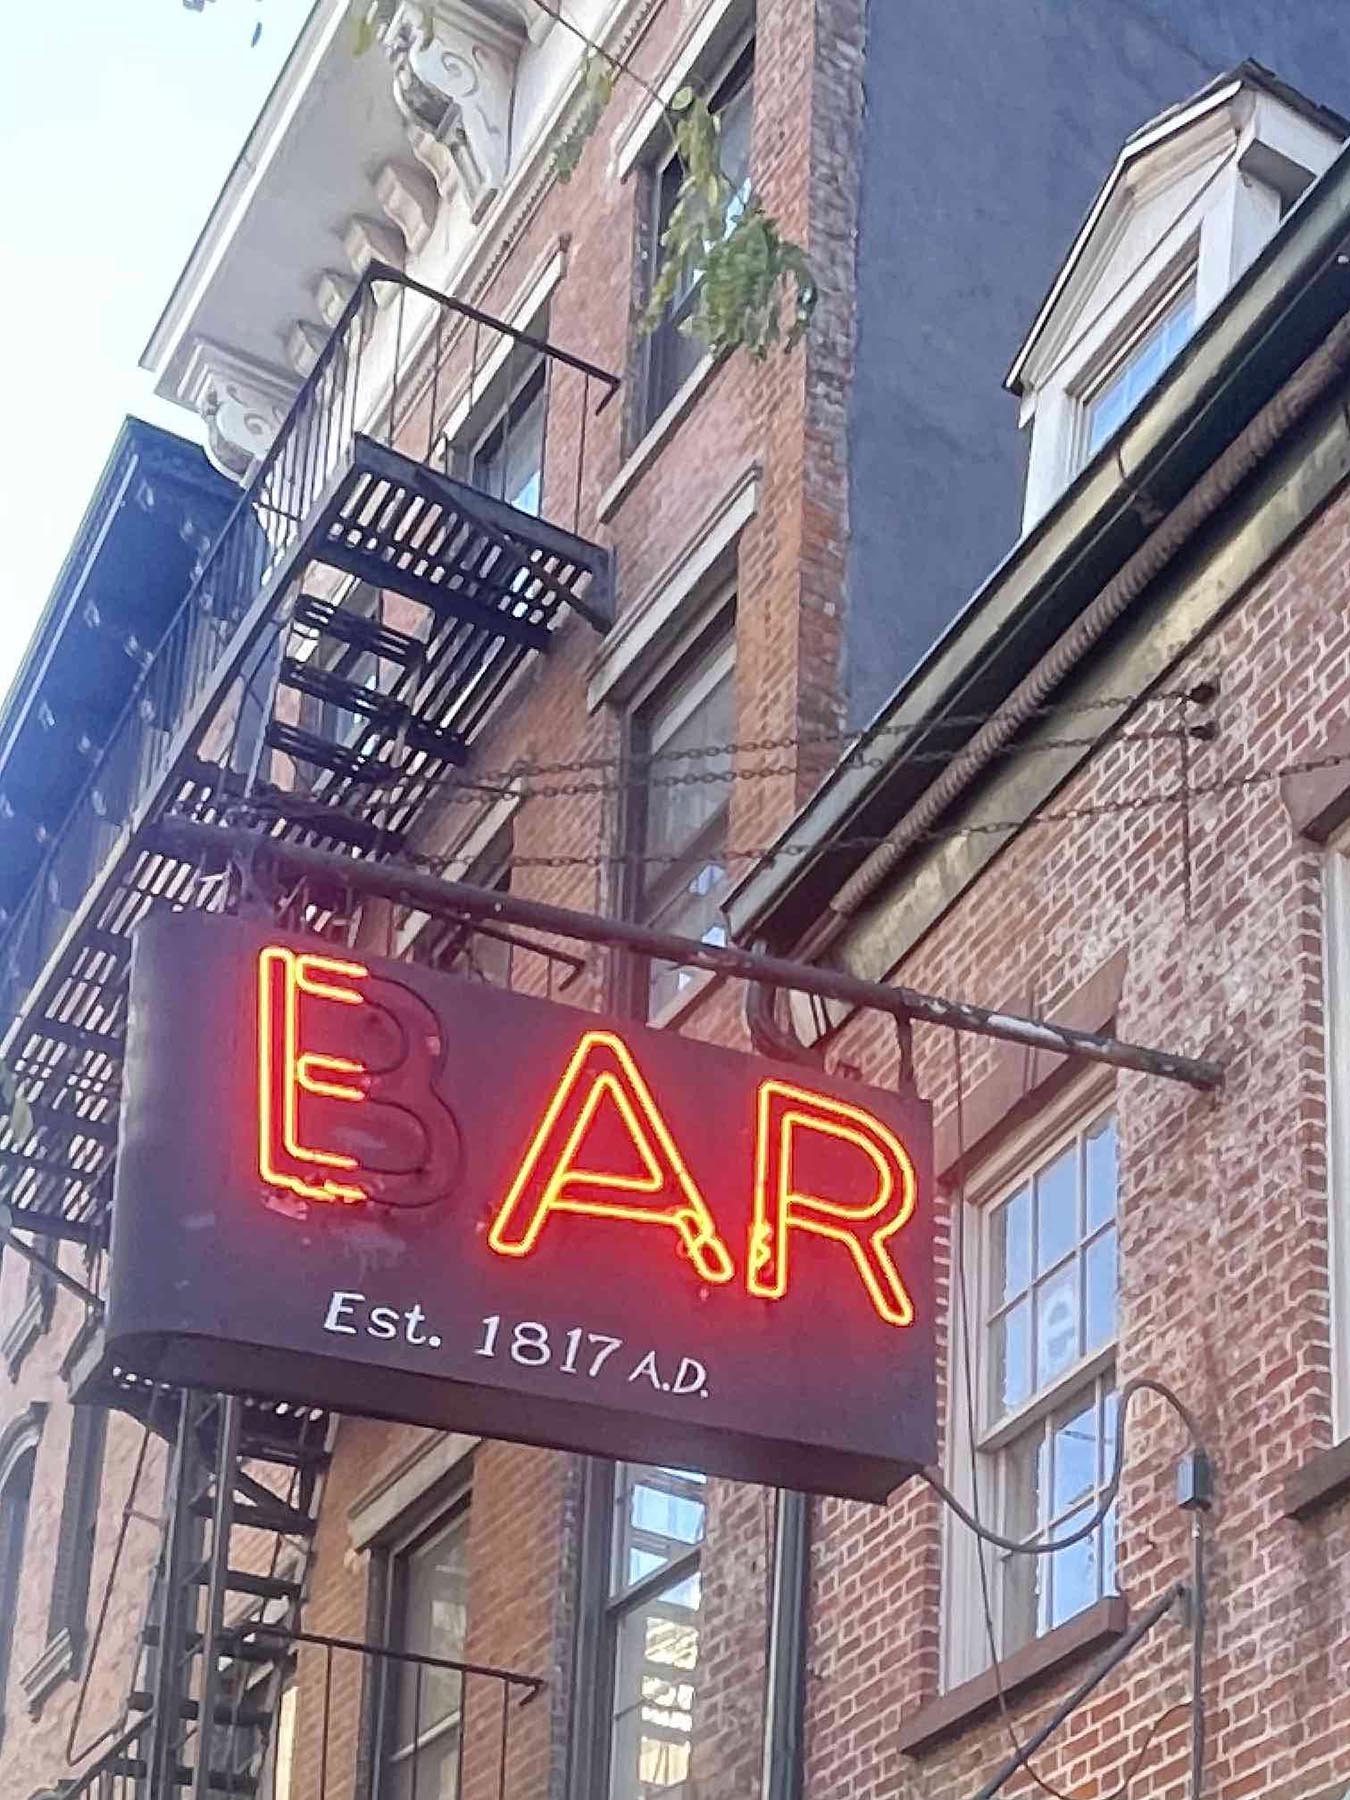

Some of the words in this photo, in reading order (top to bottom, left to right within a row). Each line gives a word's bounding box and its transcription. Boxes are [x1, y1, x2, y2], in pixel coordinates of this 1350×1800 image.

[258, 945, 916, 1327] EAR
[323, 1290, 443, 1349] Est.
[473, 1314, 623, 1377] 1817
[628, 1350, 711, 1399] A.D.
